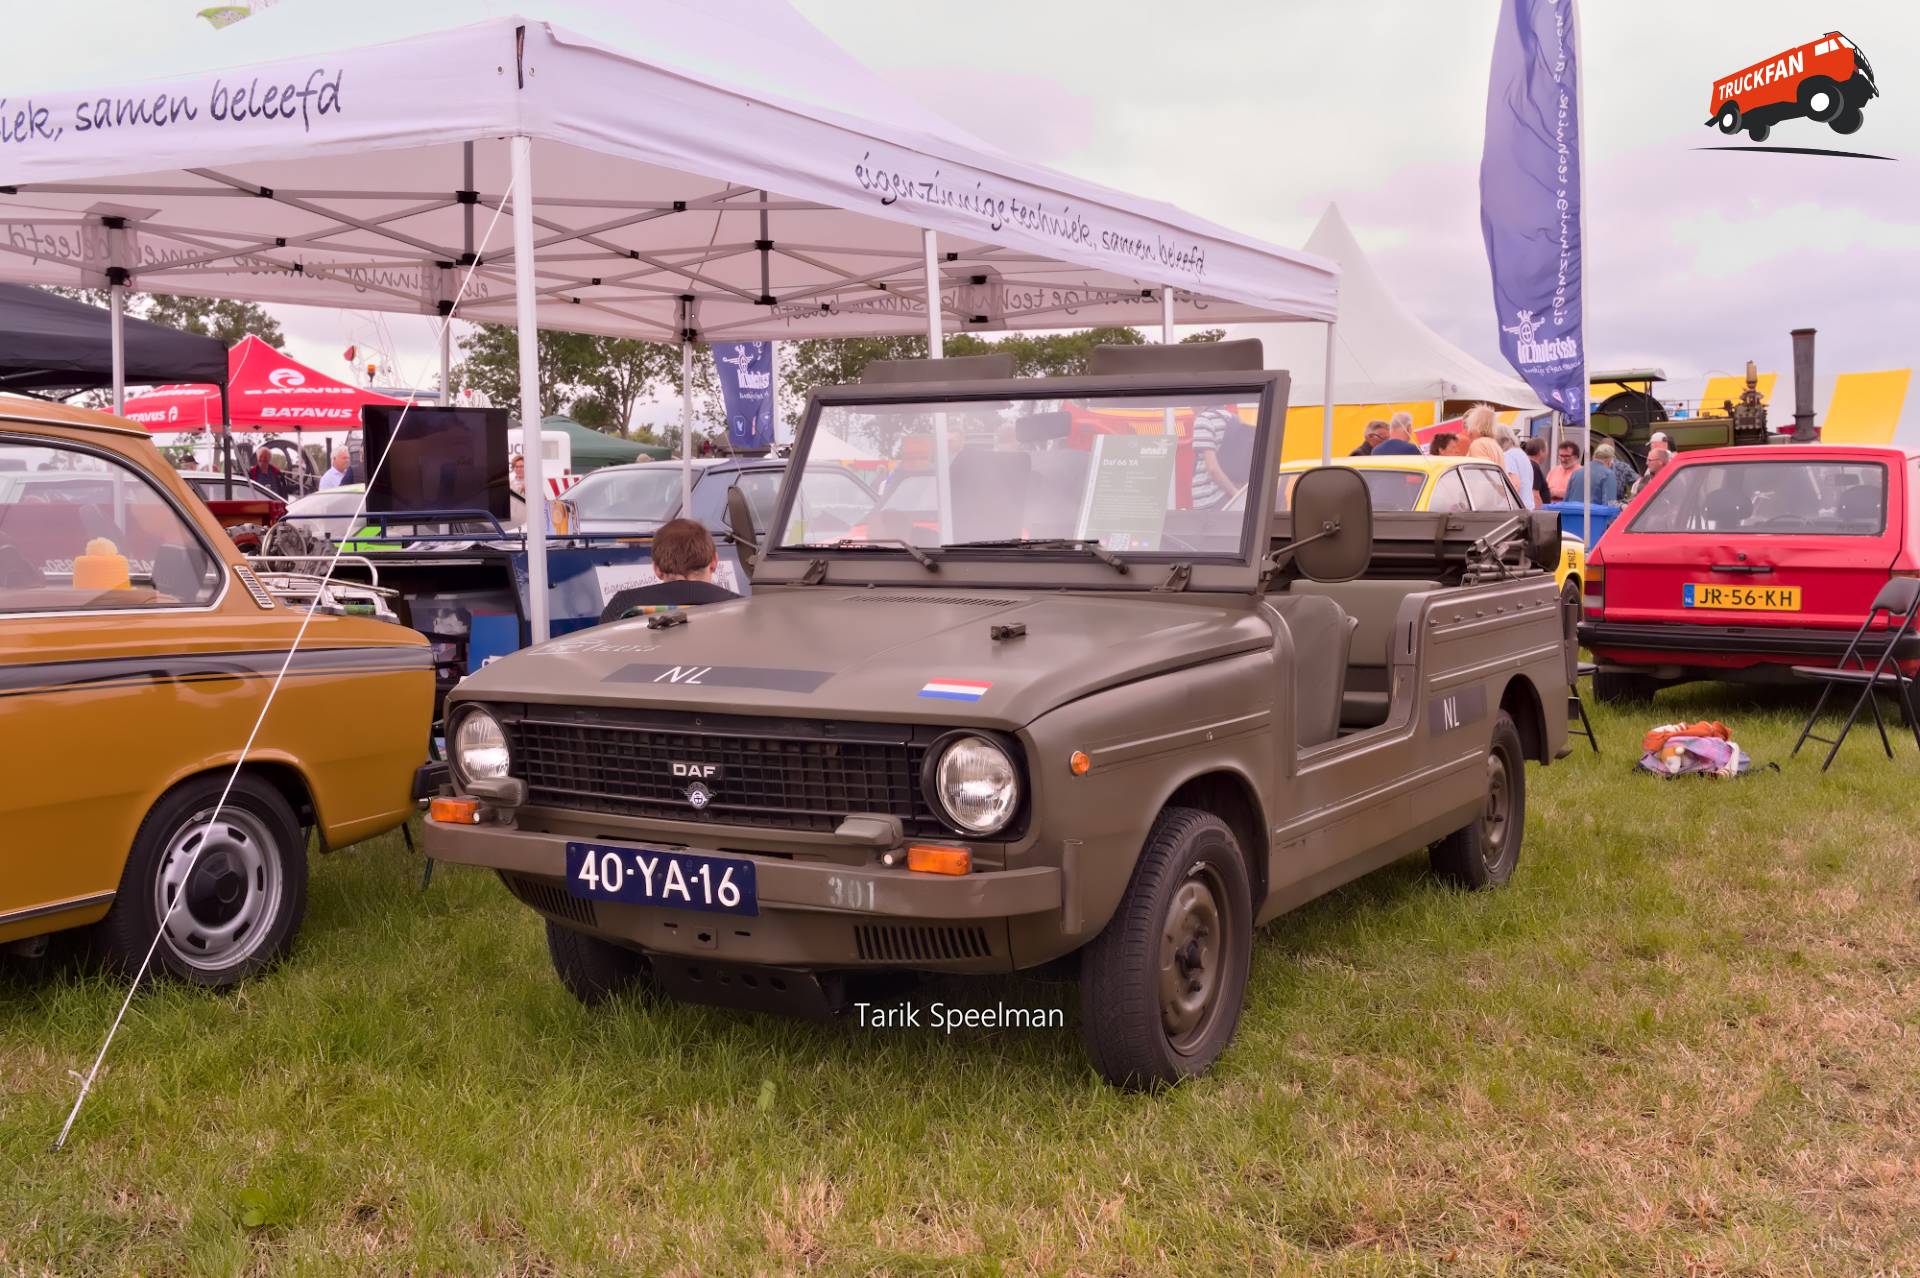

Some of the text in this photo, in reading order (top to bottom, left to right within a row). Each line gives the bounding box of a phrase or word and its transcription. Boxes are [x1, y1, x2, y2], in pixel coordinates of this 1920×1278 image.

[75, 93, 197, 131] samen
[210, 69, 343, 132] beleefd
[261, 407, 353, 418] BATAVUS
[1699, 587, 1792, 607] JR-56-KH
[653, 666, 713, 685] NL
[1443, 696, 1460, 731] NL
[673, 763, 716, 778] DAF
[578, 850, 741, 907] 40-YA-16
[828, 876, 875, 911] 301
